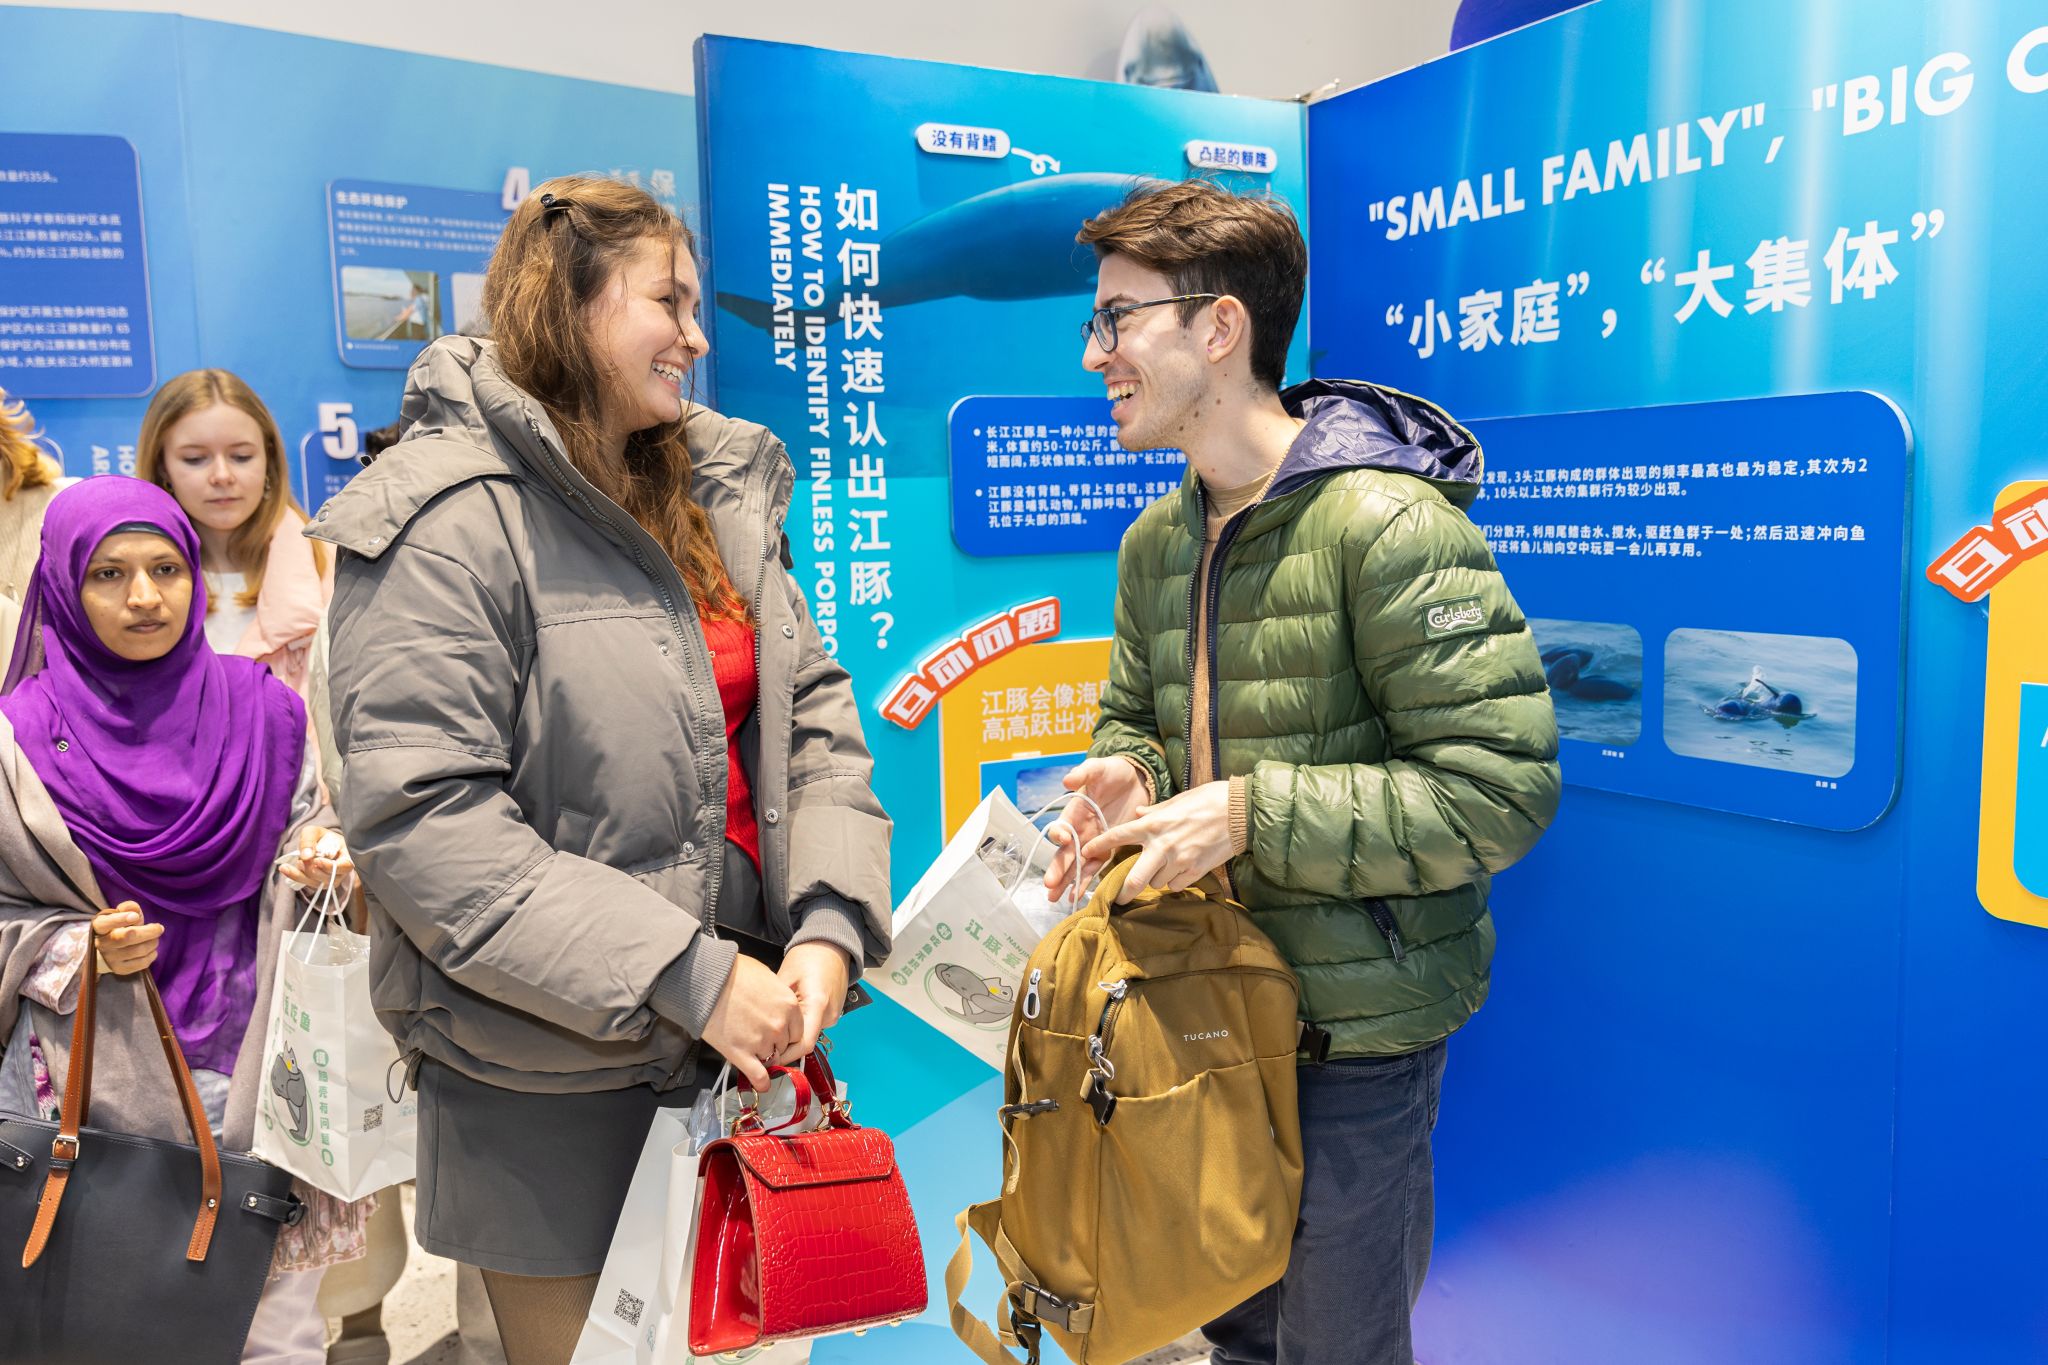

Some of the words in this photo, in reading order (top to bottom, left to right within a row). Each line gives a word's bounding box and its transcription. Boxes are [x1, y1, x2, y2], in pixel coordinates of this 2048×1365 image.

[932, 130, 997, 152] 没有背鳍
[1368, 167, 1526, 241] "SMALL
[1542, 102, 1785, 206] FAMILY",
[1811, 51, 1975, 137] "BIG
[799, 185, 823, 262] HOW
[767, 182, 797, 373] IMMEDIATELY
[802, 268, 825, 308] TO
[804, 315, 831, 439] IDENTIFY
[834, 183, 895, 650] 如何快速认出江豚？
[809, 447, 836, 553] FINLESS
[814, 560, 840, 662] PORPO
[1428, 600, 1484, 631] Carlsberg
[1183, 1029, 1229, 1042] TUCANO
